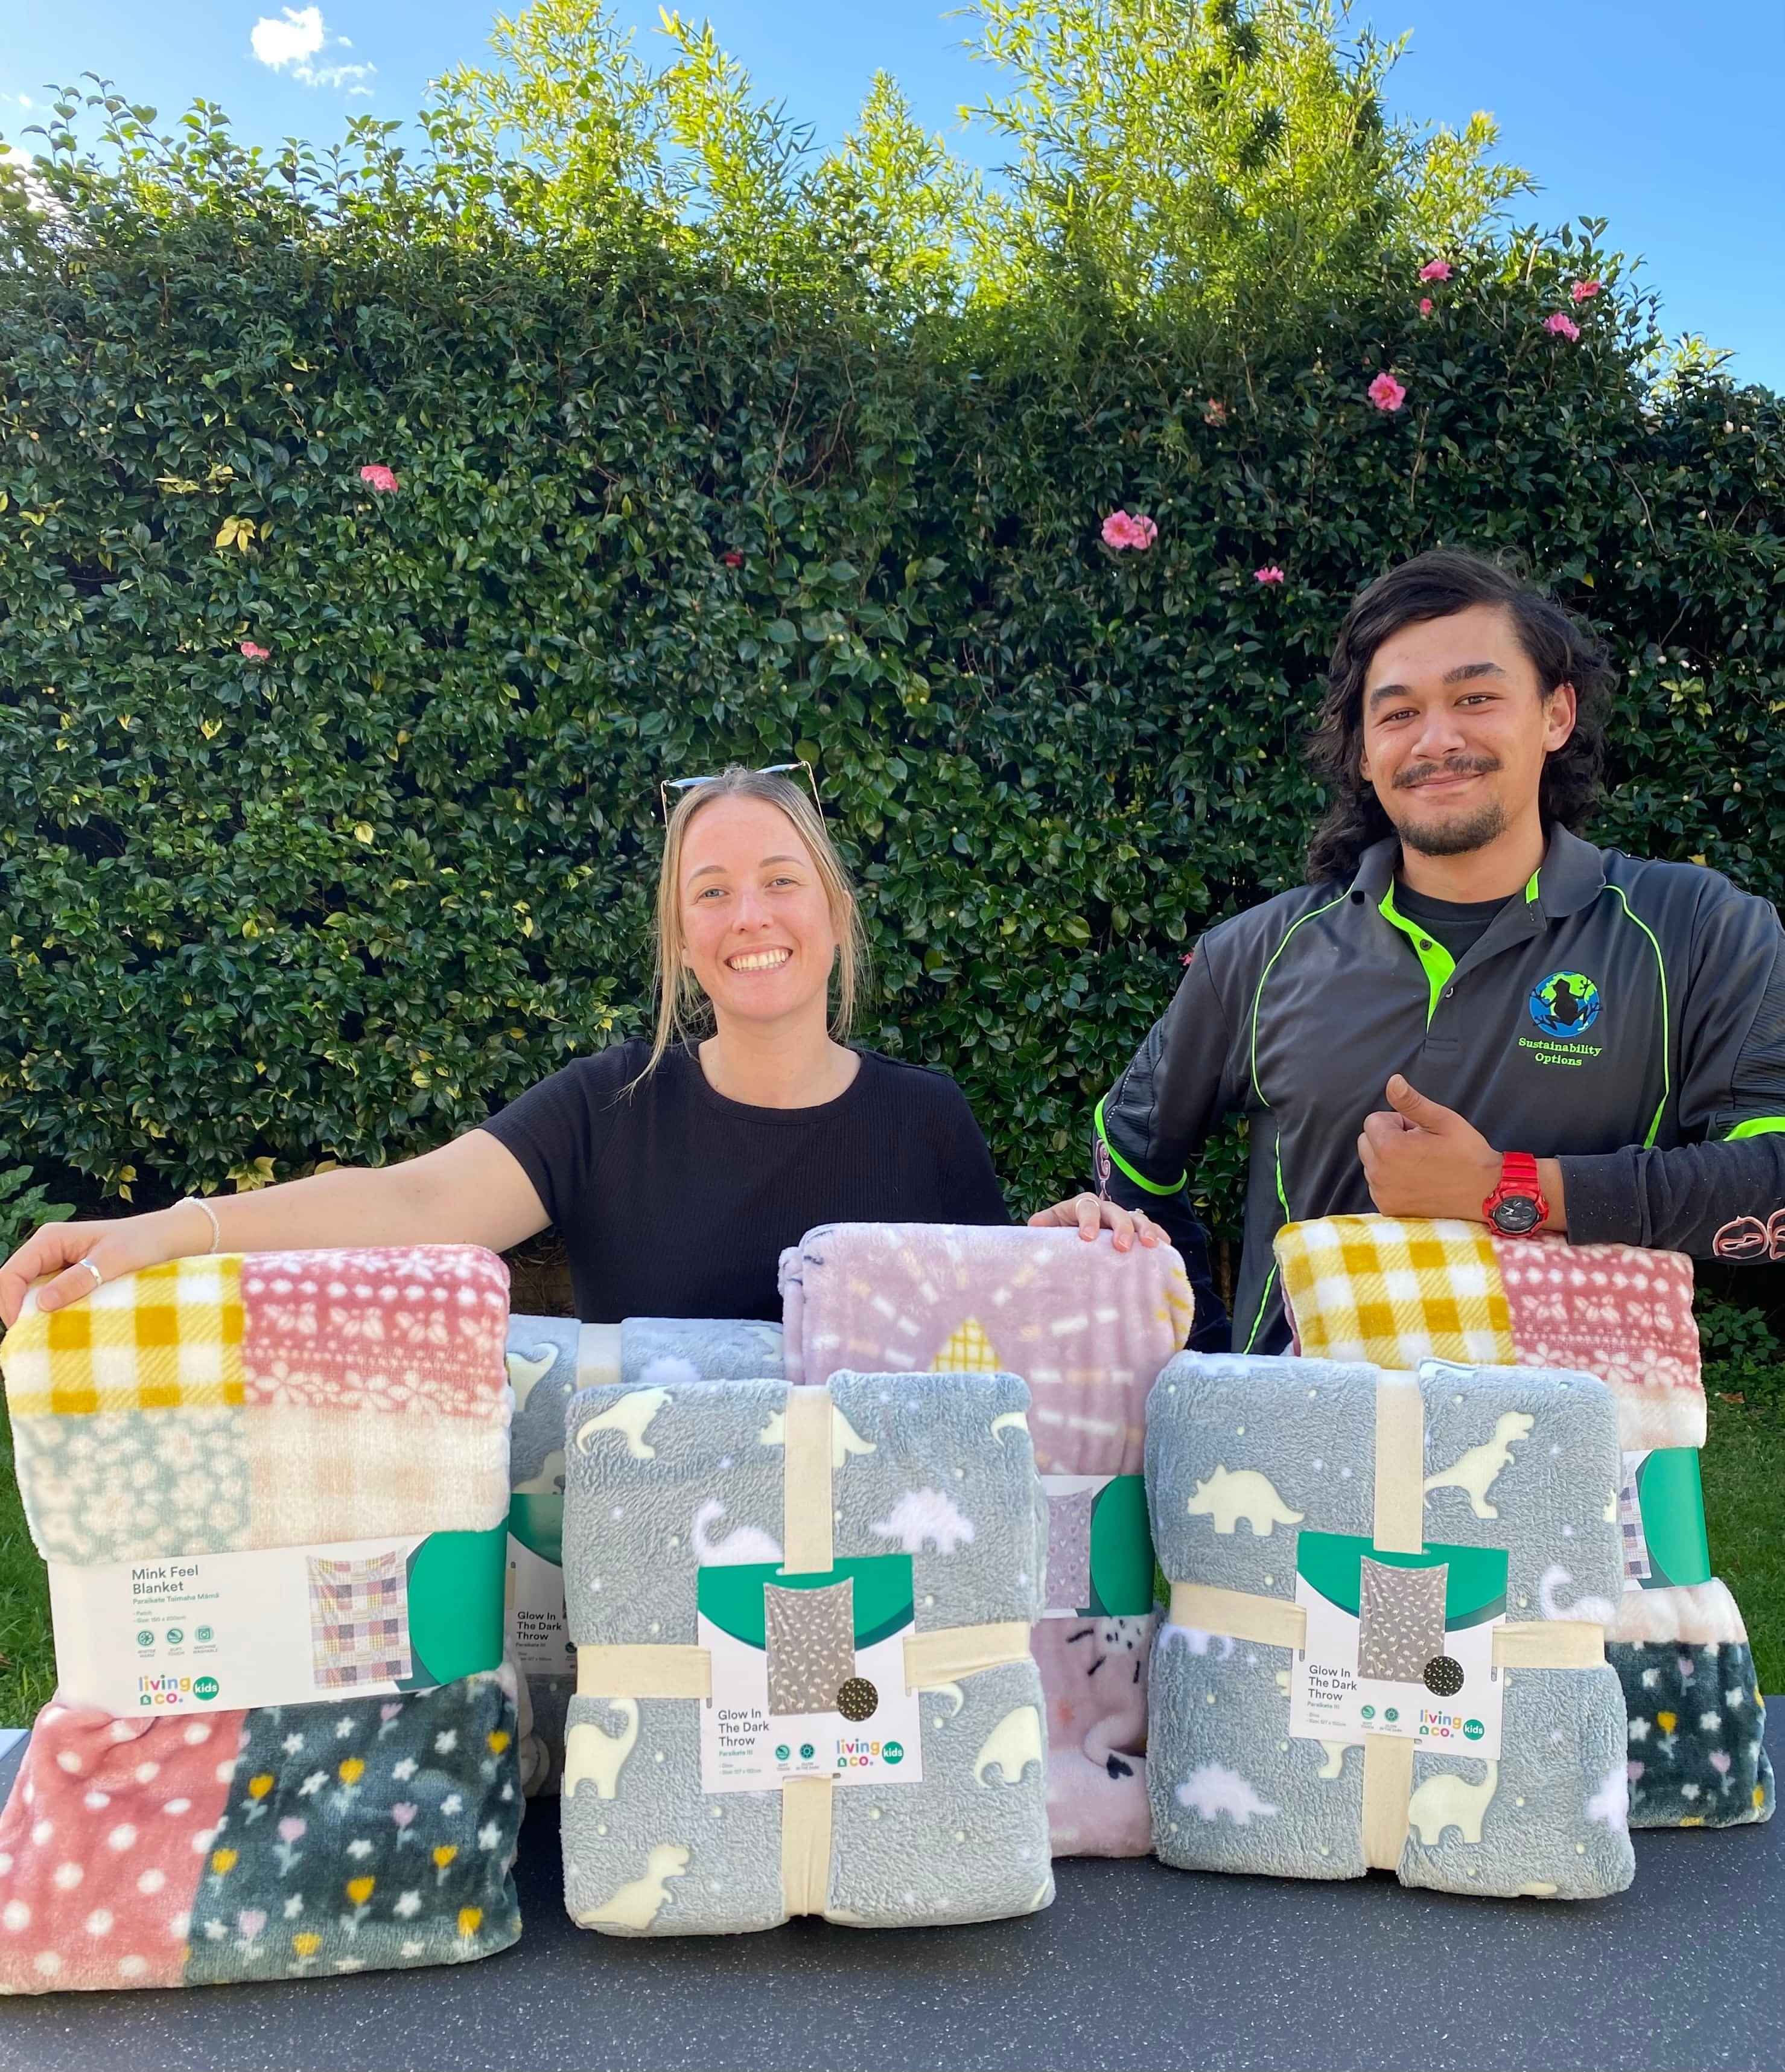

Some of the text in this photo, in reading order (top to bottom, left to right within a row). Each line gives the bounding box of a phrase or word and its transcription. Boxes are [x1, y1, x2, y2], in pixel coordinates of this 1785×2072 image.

[1518, 1038, 1603, 1056] Sustainability
[1535, 1053, 1582, 1066] Options
[132, 1564, 199, 1580] Mink Feel
[133, 1581, 183, 1594] Blanket
[518, 1611, 544, 1619] Glow
[1309, 1665, 1351, 1678] Glow In
[139, 1674, 217, 1693] living kids
[1309, 1677, 1357, 1690] The Dark
[1308, 1689, 1343, 1701] Throw
[718, 1709, 761, 1720] Glow In
[718, 1721, 769, 1733] The Dark
[1420, 1709, 1483, 1735] living kids
[719, 1736, 755, 1747] Throw
[837, 1738, 903, 1757] living kids
